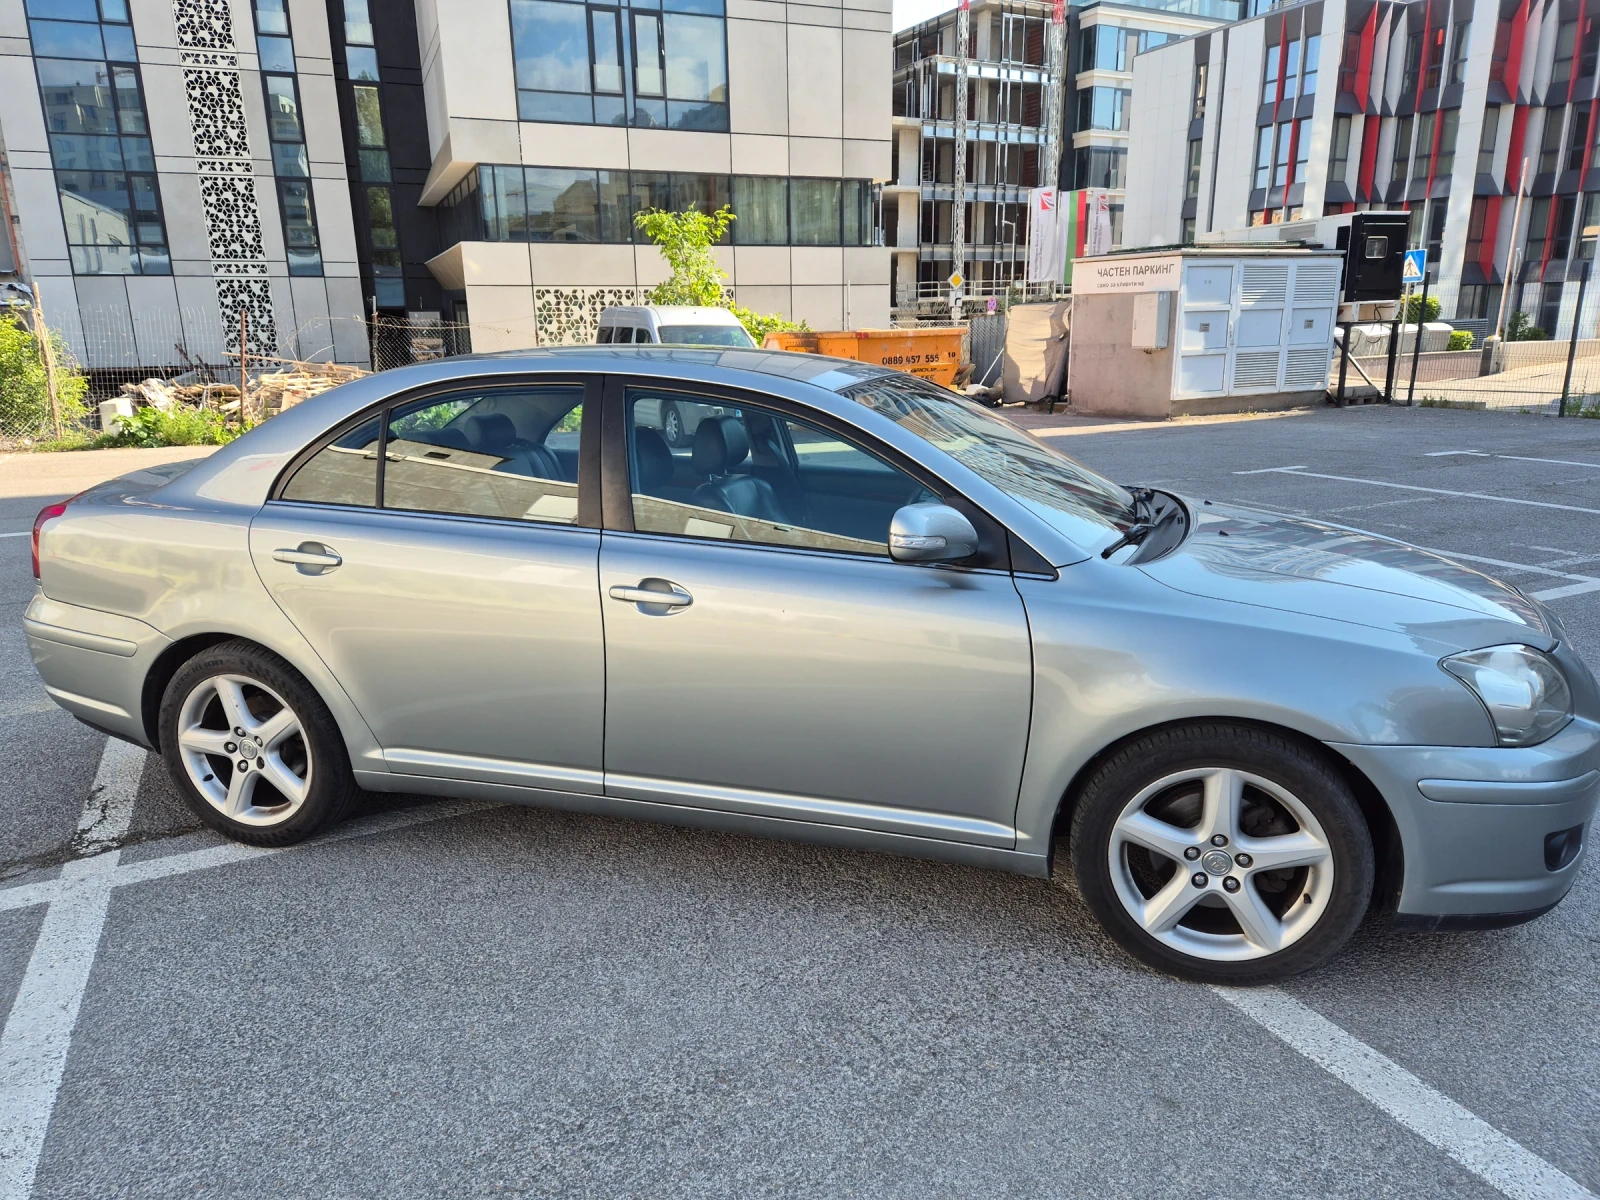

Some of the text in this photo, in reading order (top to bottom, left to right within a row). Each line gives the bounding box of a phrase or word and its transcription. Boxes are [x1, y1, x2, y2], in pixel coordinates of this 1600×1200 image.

[1097, 263, 1175, 277] ЧАСТЕН ПАРКИНГ
[882, 356, 904, 365] 0889
[925, 354, 939, 363] 555
